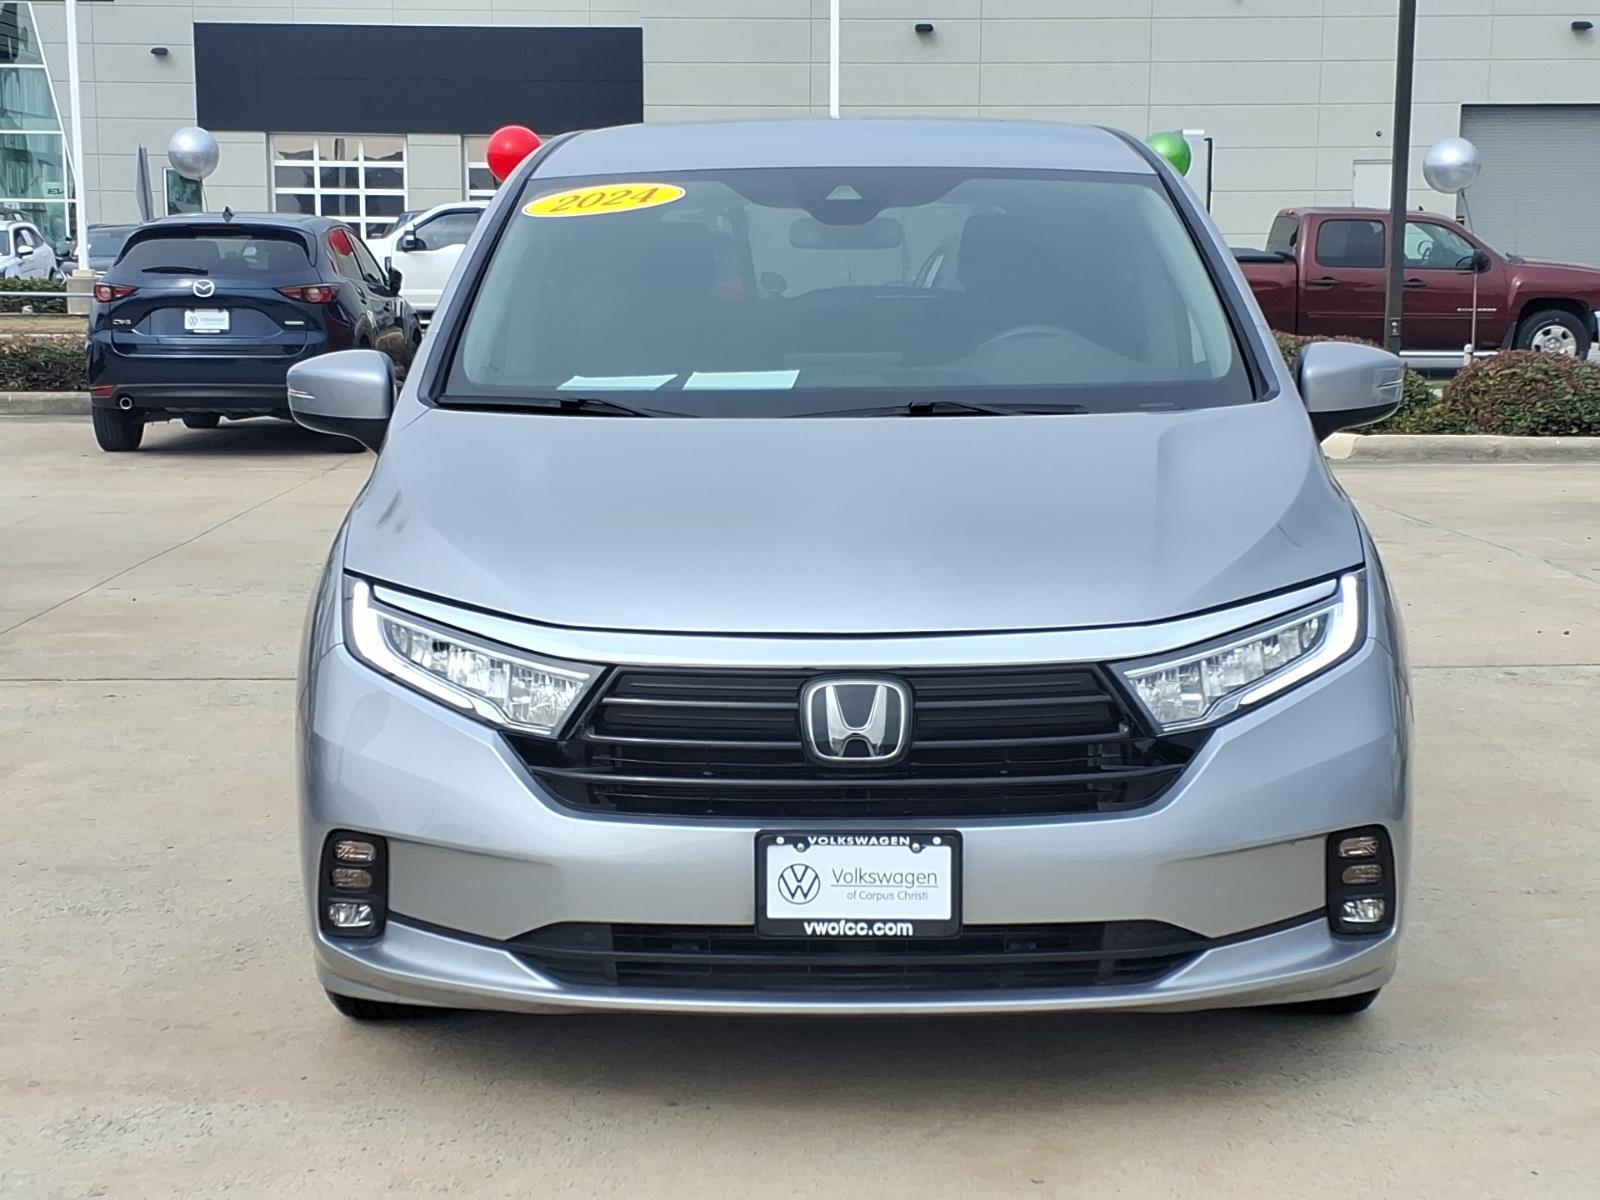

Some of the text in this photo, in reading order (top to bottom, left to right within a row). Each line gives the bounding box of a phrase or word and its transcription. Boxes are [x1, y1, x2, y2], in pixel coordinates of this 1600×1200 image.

[549, 187, 659, 213] 2024
[807, 836, 910, 846] VOLKSWAGEN
[831, 867, 938, 888] Volkswagen
[847, 890, 928, 902] of Corpus Christi
[803, 919, 913, 936] vwofcc.com
